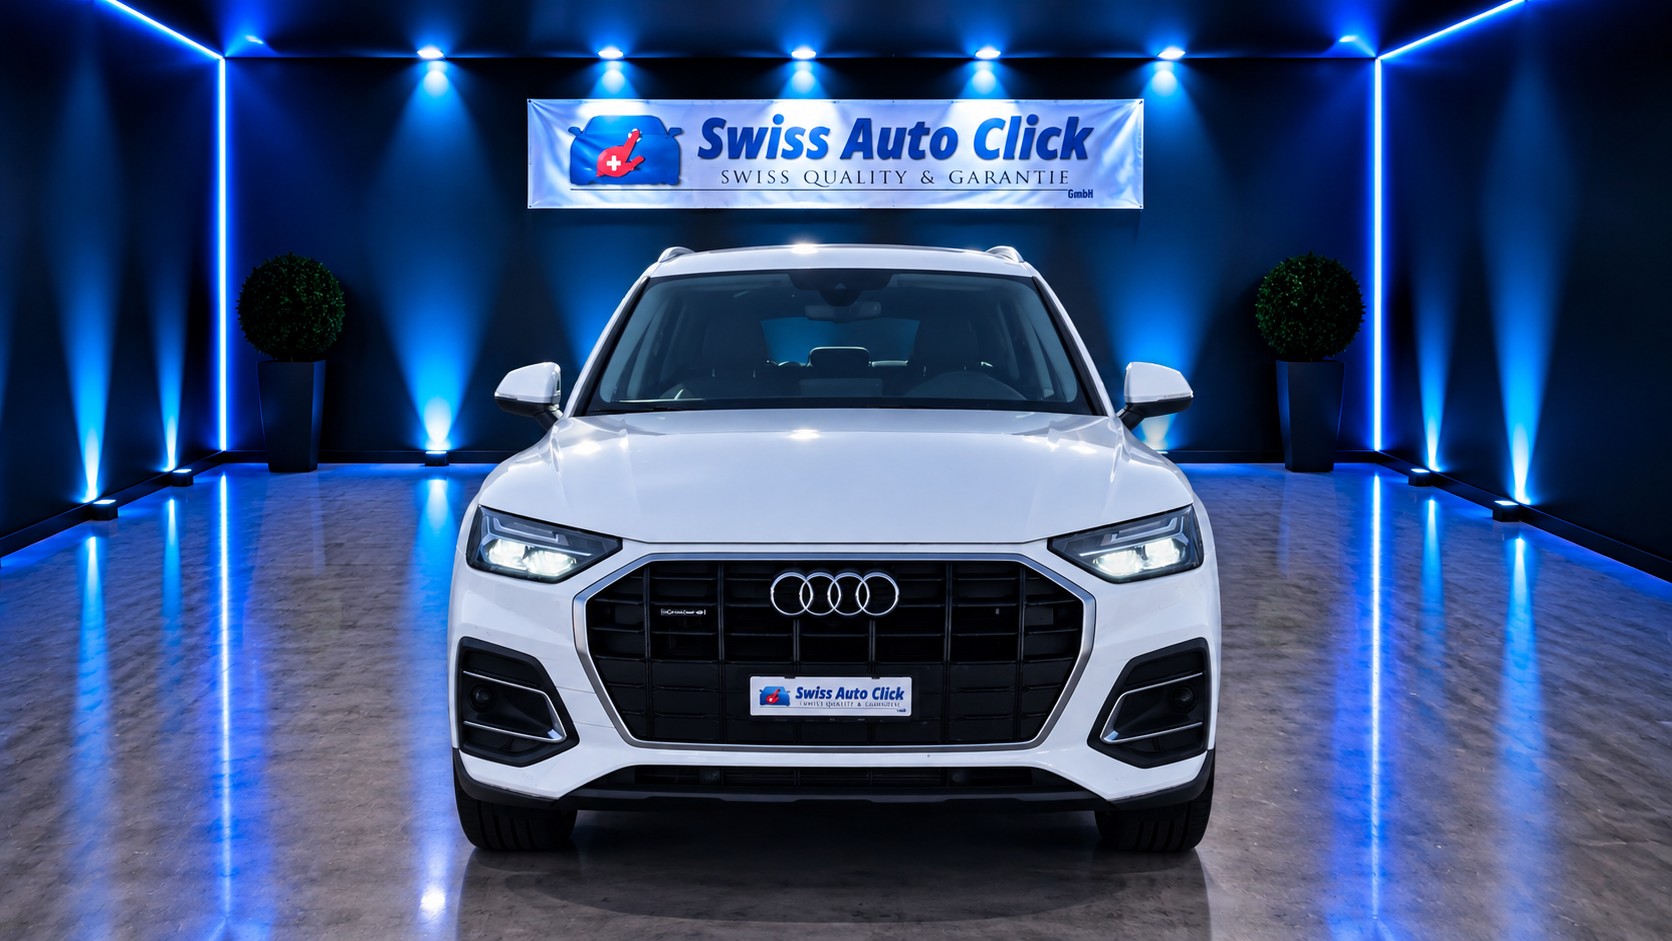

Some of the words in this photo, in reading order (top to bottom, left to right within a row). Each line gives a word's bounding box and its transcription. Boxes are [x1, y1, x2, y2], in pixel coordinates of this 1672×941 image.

[697, 113, 831, 160] Swiss
[840, 118, 959, 160] Auto
[973, 114, 1095, 160] Click
[721, 169, 790, 184] SWISS
[803, 169, 907, 188] QUALITY
[920, 170, 935, 184] &
[949, 170, 1069, 184] GARANTIE
[1068, 189, 1094, 199] GmbH
[795, 686, 833, 700] Swiss
[835, 687, 868, 700] Auto
[871, 687, 905, 700] Click
